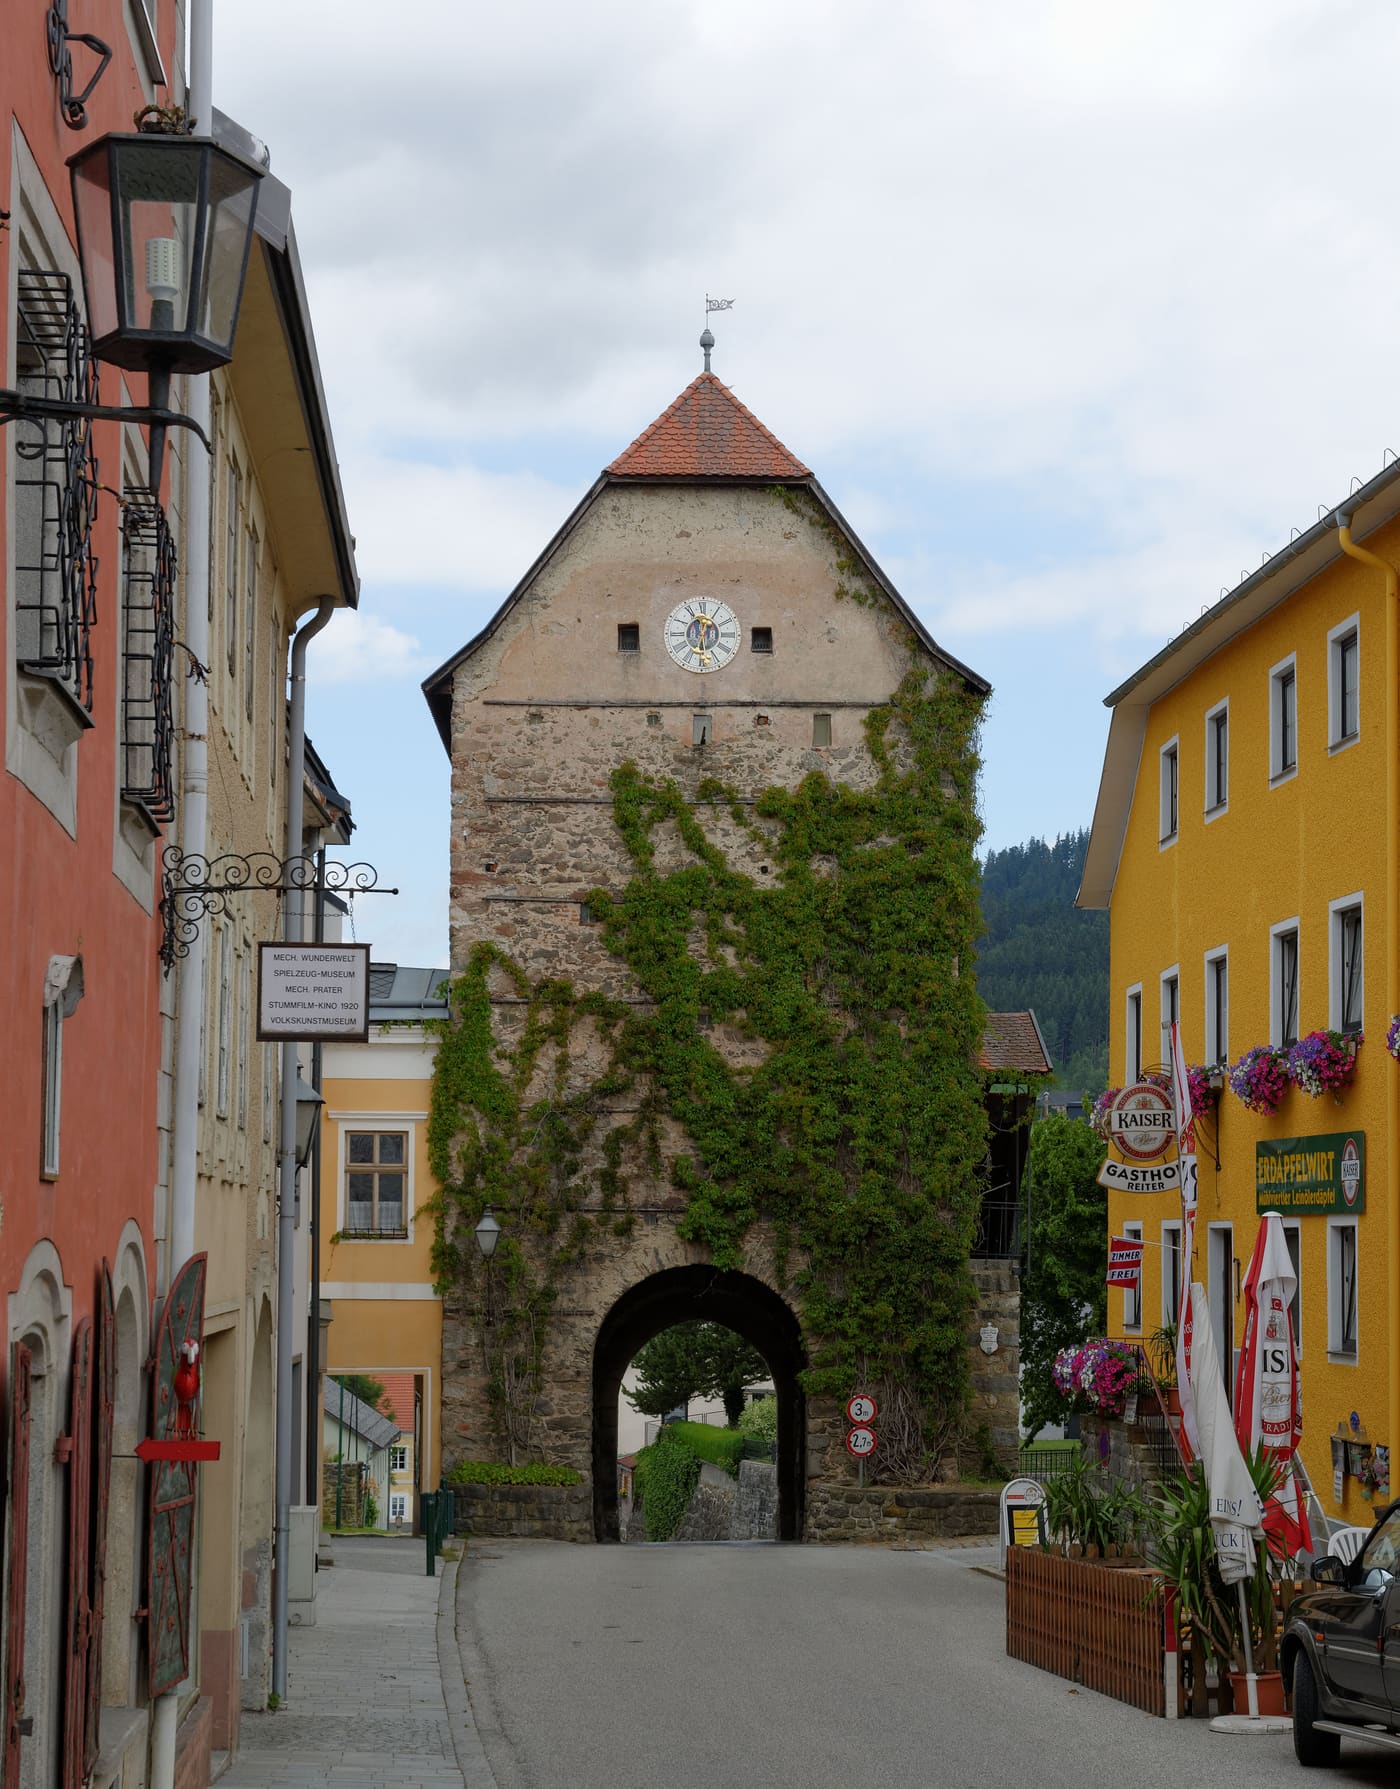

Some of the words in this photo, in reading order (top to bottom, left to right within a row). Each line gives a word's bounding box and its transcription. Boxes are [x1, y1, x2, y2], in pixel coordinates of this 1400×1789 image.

[273, 953, 298, 961] MECH.
[301, 954, 356, 962] WUNDERWELT
[273, 969, 355, 978] SPIELZEUG-MUSEUM
[313, 986, 343, 994] PRATER
[268, 1001, 338, 1009] STUMMFILM-KINO
[341, 1002, 359, 1010] 1920
[270, 1016, 357, 1025] VOLKSKUNSTMUSEUM
[1118, 1112, 1172, 1129] KAISER
[1257, 1149, 1335, 1184] ERDÄPFELWIRT
[1343, 1162, 1358, 1179] KAISER
[1106, 1164, 1180, 1181] GASTHO
[1127, 1182, 1165, 1190] REITER
[1111, 1250, 1140, 1261] ZIMMER
[1111, 1269, 1135, 1279] FREI
